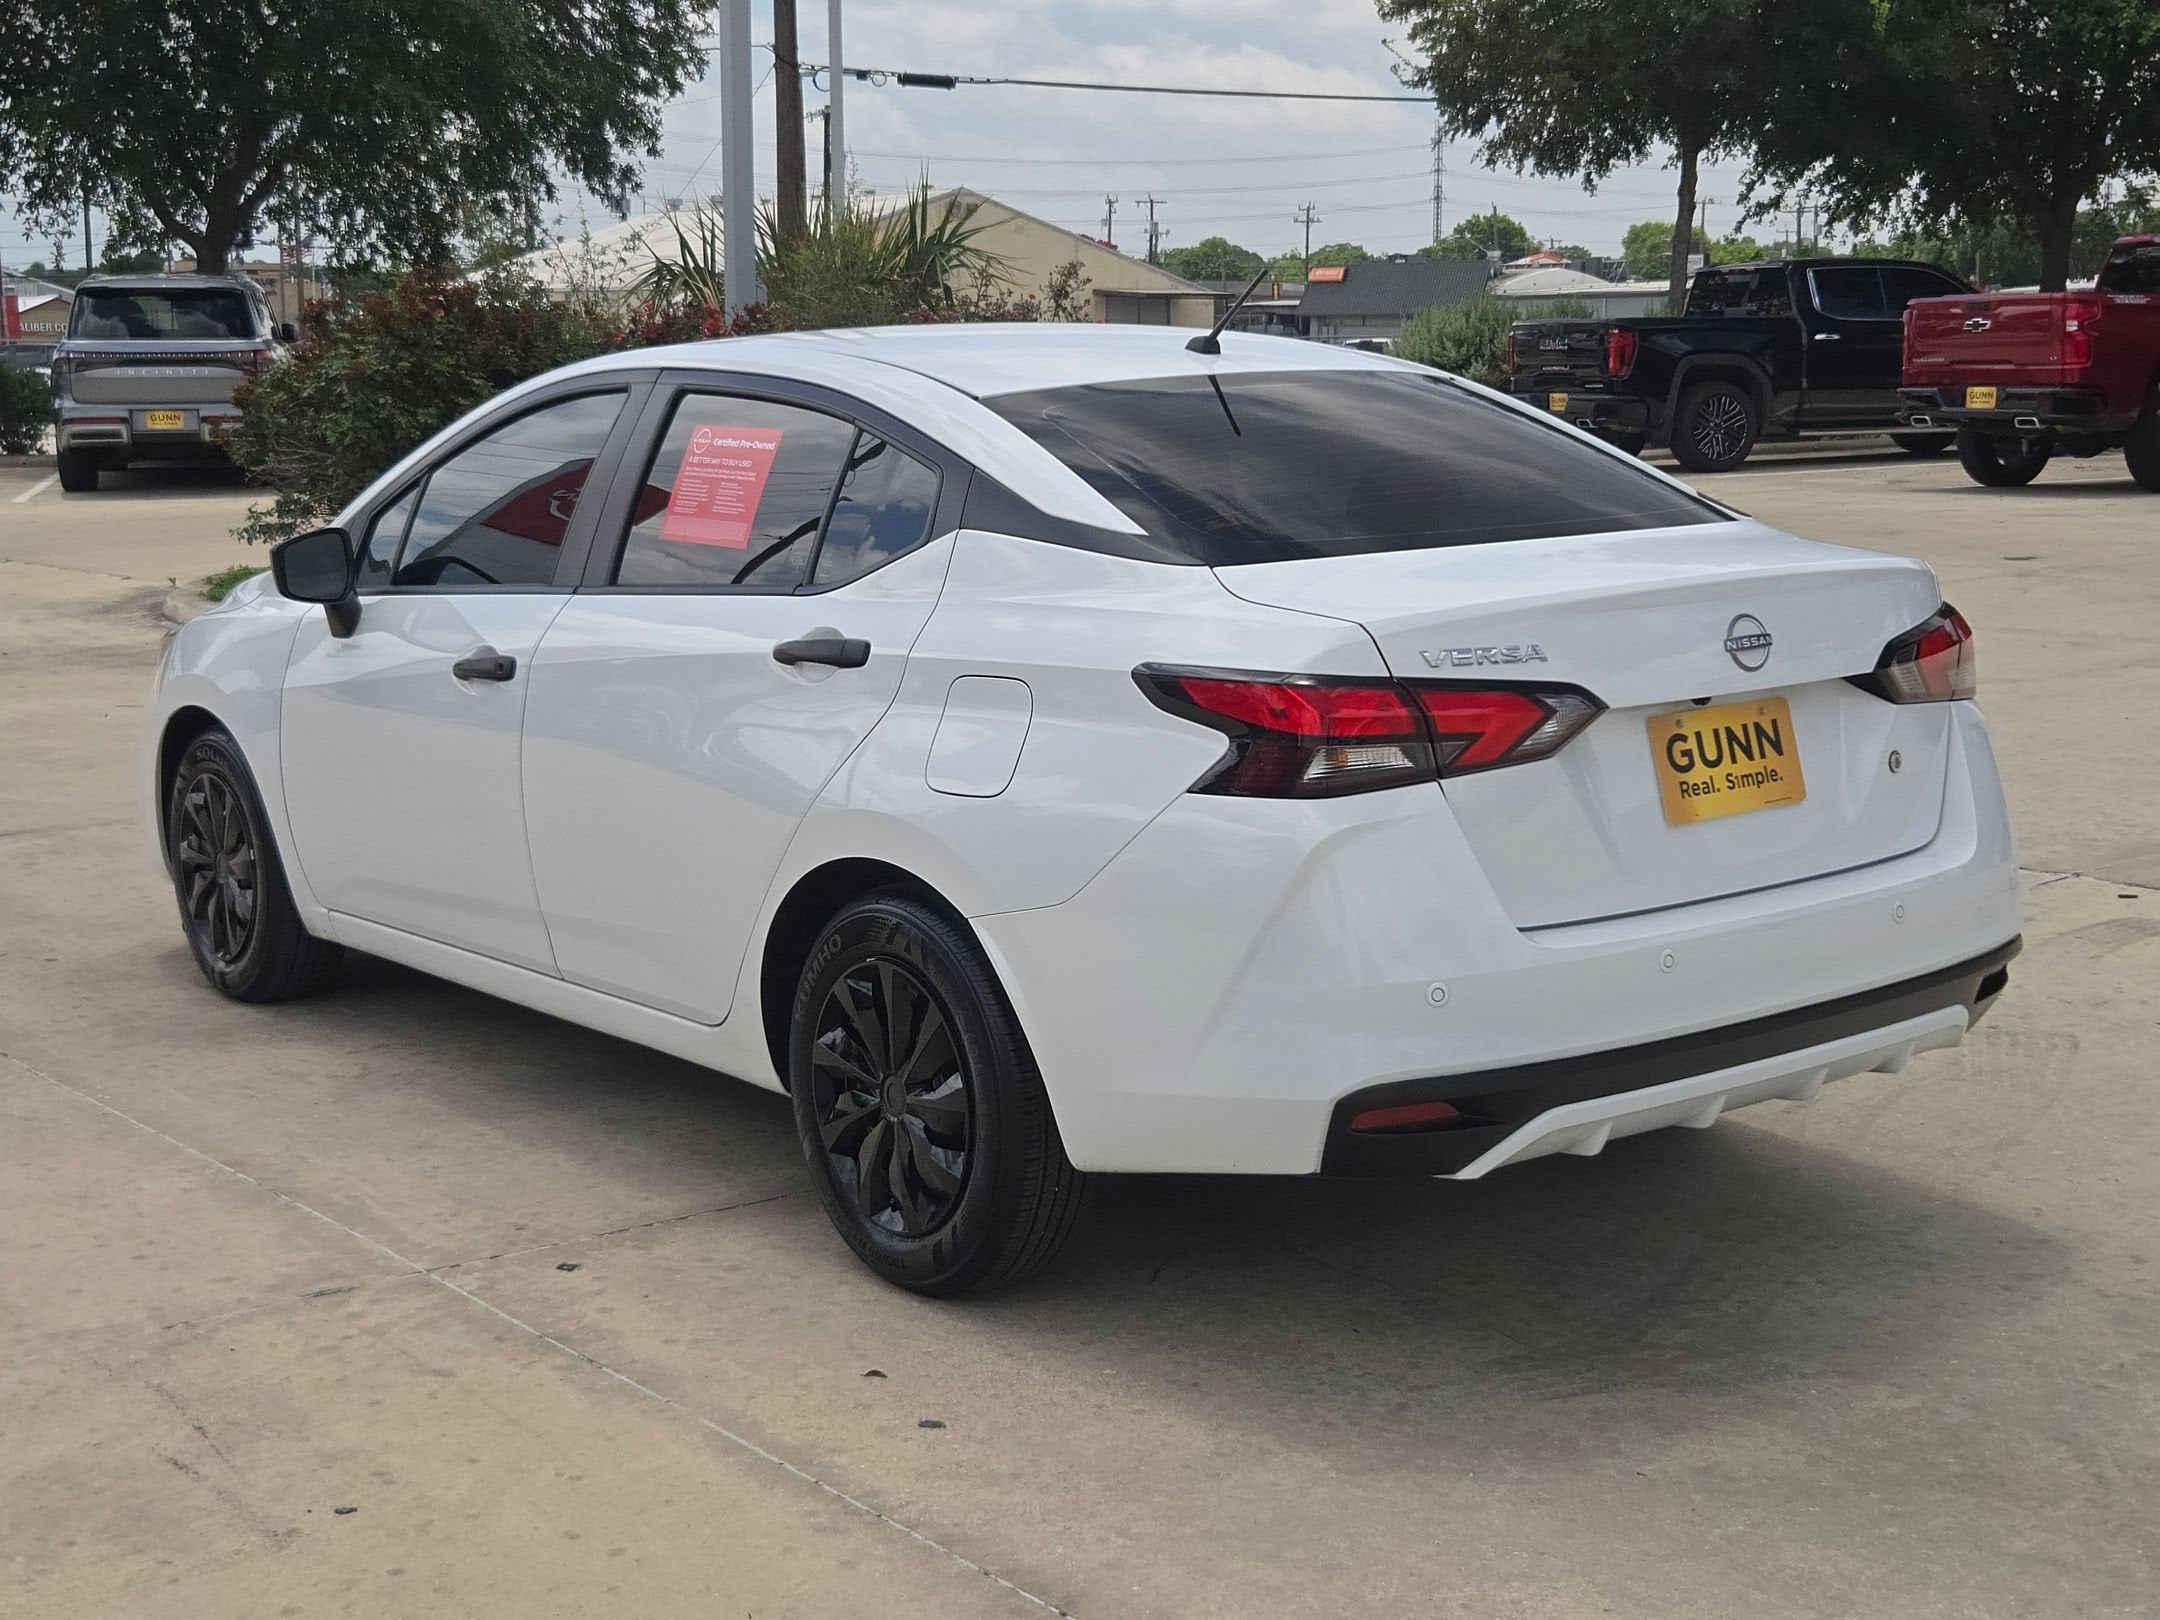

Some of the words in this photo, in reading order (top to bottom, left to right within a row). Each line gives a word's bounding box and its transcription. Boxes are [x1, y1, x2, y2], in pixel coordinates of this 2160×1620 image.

[20, 322, 53, 332] ALIBER
[1969, 391, 1994, 400] GUNN
[150, 413, 181, 422] GUNN
[713, 438, 740, 448] Certified
[740, 439, 776, 450] Pre-Owned
[1727, 634, 1772, 650] NISSAN
[1419, 643, 1548, 668] VERSA
[1666, 718, 1784, 774] GUNN
[1679, 775, 1721, 799] Real.
